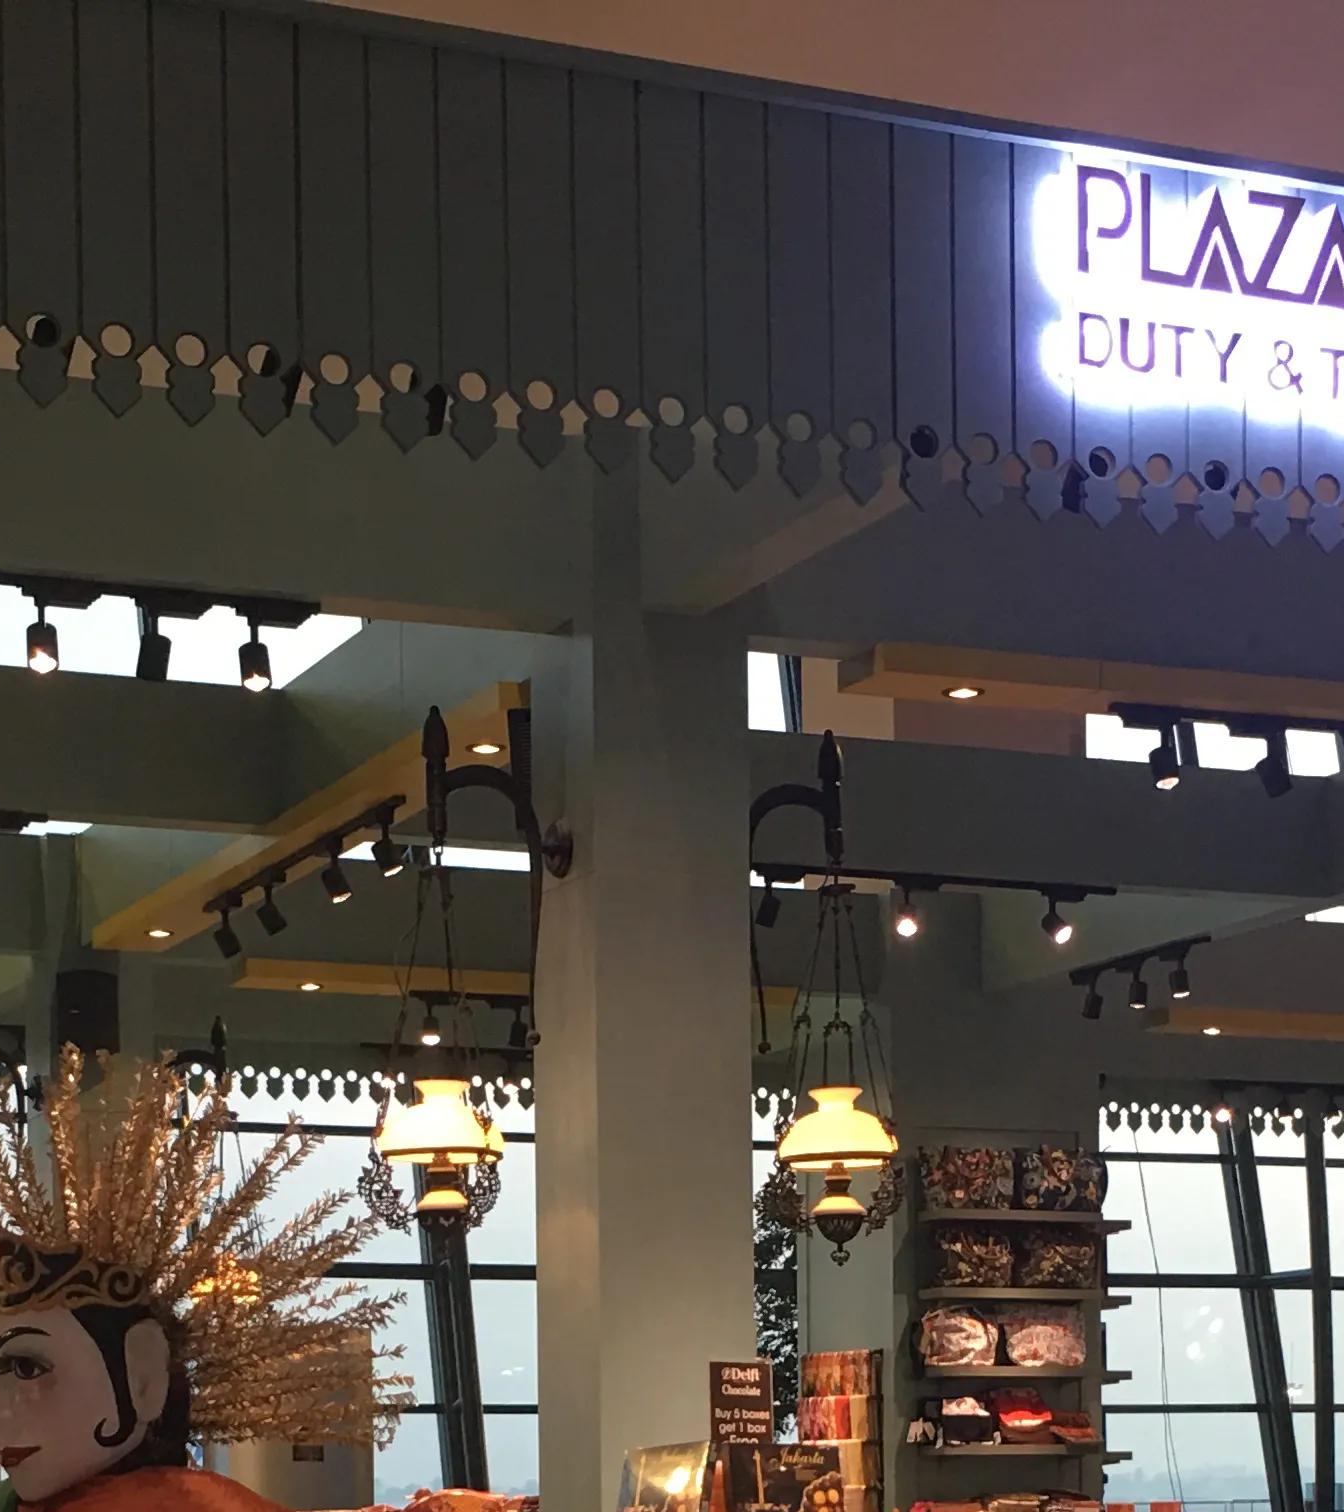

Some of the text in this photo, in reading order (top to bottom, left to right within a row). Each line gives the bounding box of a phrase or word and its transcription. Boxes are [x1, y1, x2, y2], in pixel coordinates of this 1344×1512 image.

[1078, 311, 1242, 384] DUTY
[1267, 339, 1304, 395] &
[729, 1367, 760, 1382] Delfi
[722, 1384, 761, 1397] Chocolate
[715, 1408, 732, 1420] Buy
[742, 1409, 770, 1420] boxes
[719, 1422, 736, 1435] get
[747, 1422, 767, 1433] box
